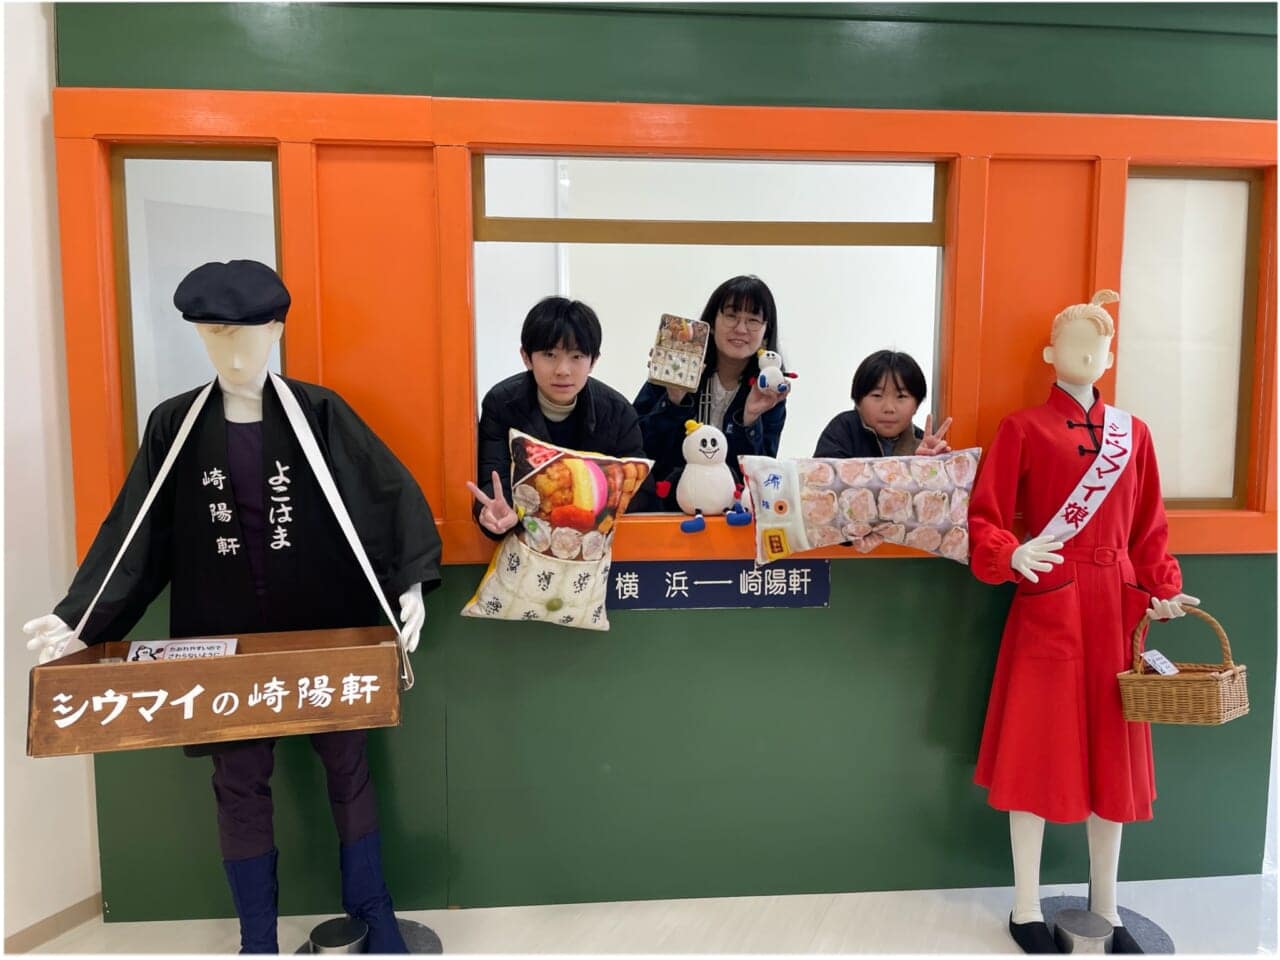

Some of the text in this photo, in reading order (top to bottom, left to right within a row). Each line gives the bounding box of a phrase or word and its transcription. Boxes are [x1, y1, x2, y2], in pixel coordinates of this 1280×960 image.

[202, 467, 241, 557] 崎陽軒
[268, 460, 293, 551] よこはま
[1061, 422, 1129, 530] シウマイ娘
[739, 567, 812, 597] 崎陽軒
[52, 672, 381, 729] シウマイの崎陽軒
